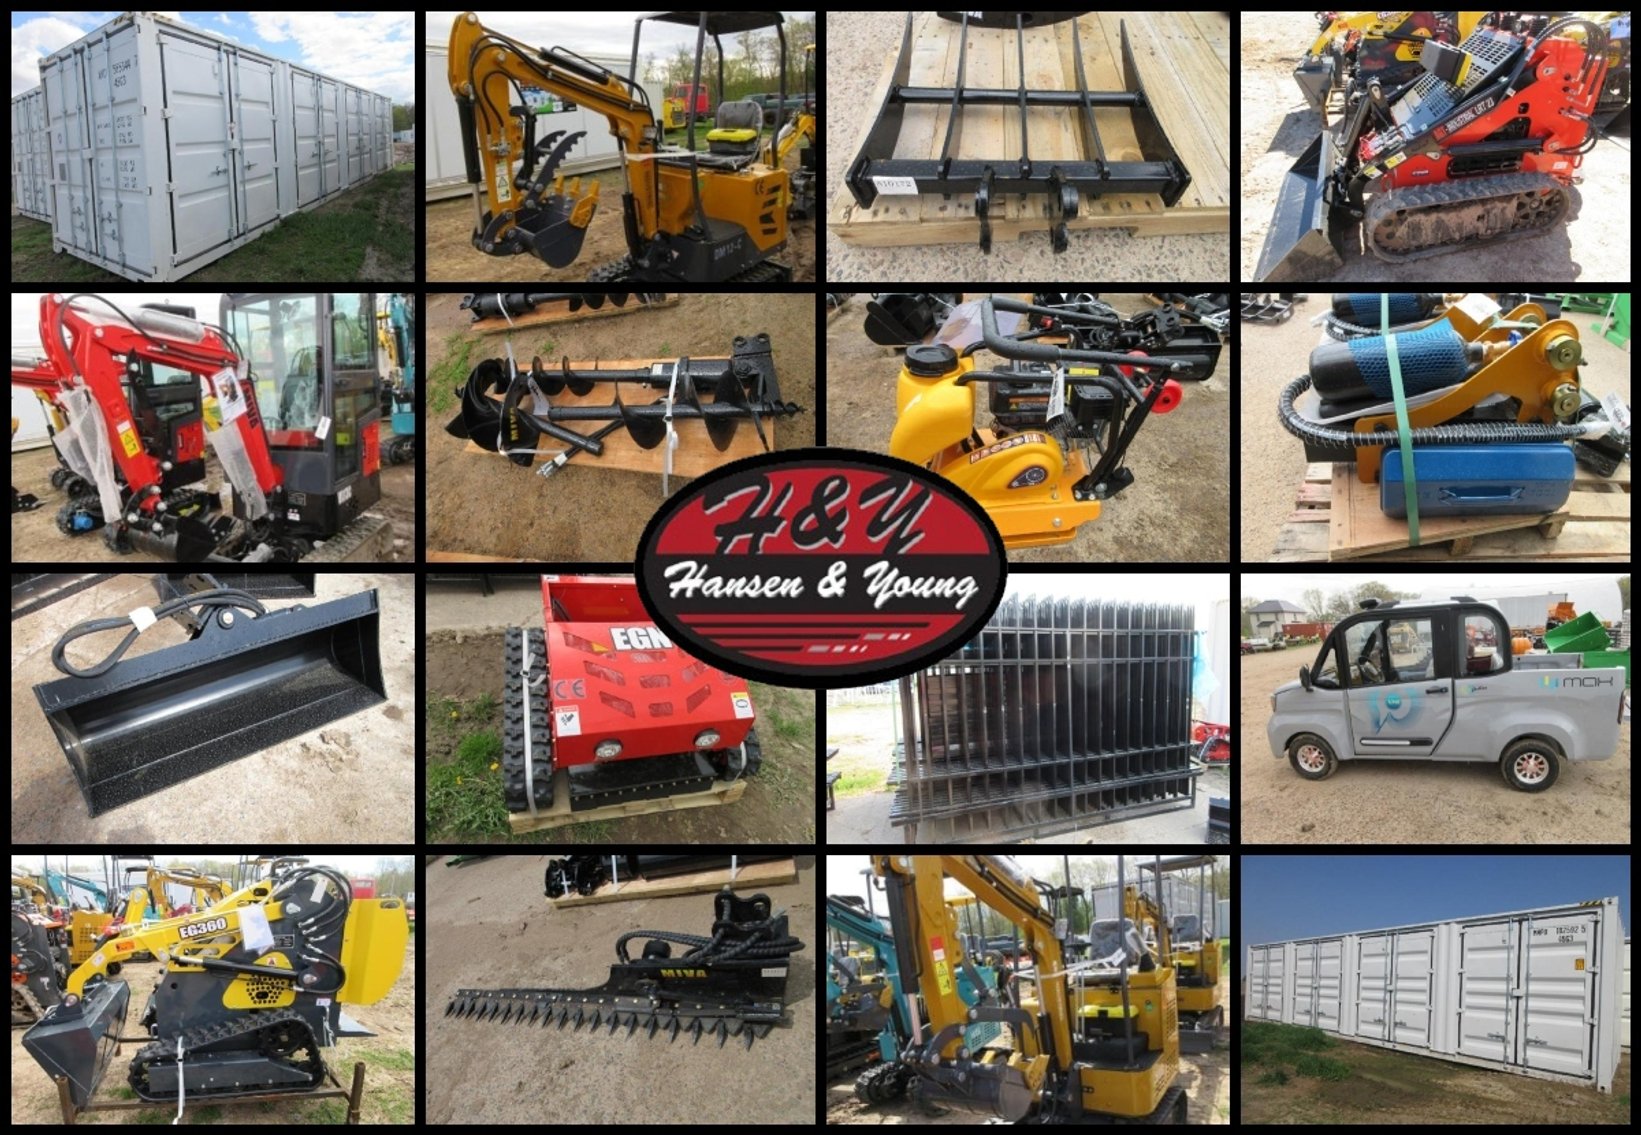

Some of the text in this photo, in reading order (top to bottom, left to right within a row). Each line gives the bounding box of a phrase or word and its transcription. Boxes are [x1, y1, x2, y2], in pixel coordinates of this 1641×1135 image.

[609, 626, 673, 651] EGN
[555, 680, 585, 699] CE
[179, 917, 227, 939] EG360
[660, 968, 708, 978] MIVA
